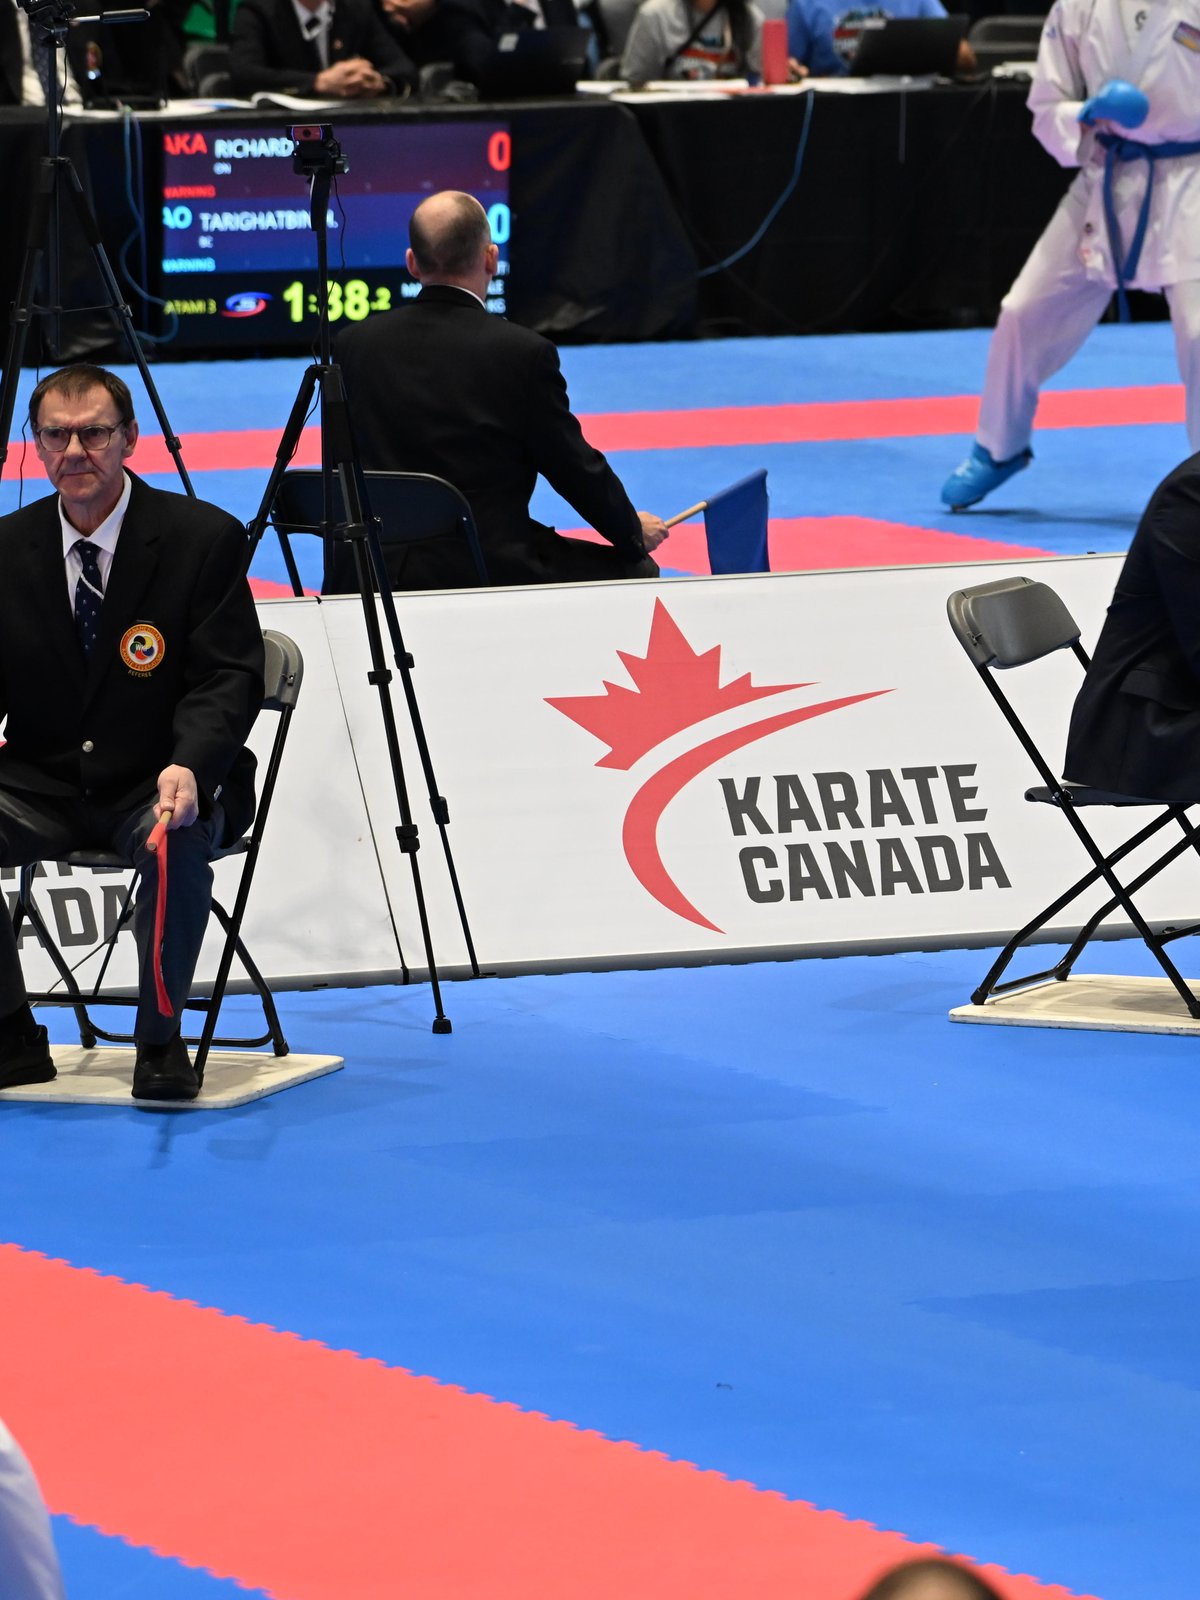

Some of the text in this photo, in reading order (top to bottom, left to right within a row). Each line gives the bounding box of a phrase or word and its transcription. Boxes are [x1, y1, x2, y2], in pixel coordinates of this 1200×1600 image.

[214, 137, 299, 158] RICHARD
[488, 131, 511, 171] 0
[163, 299, 207, 315] ATAMI
[718, 763, 988, 836] KARATE
[738, 832, 1012, 904] CANADA
[5, 885, 137, 950] ADA
